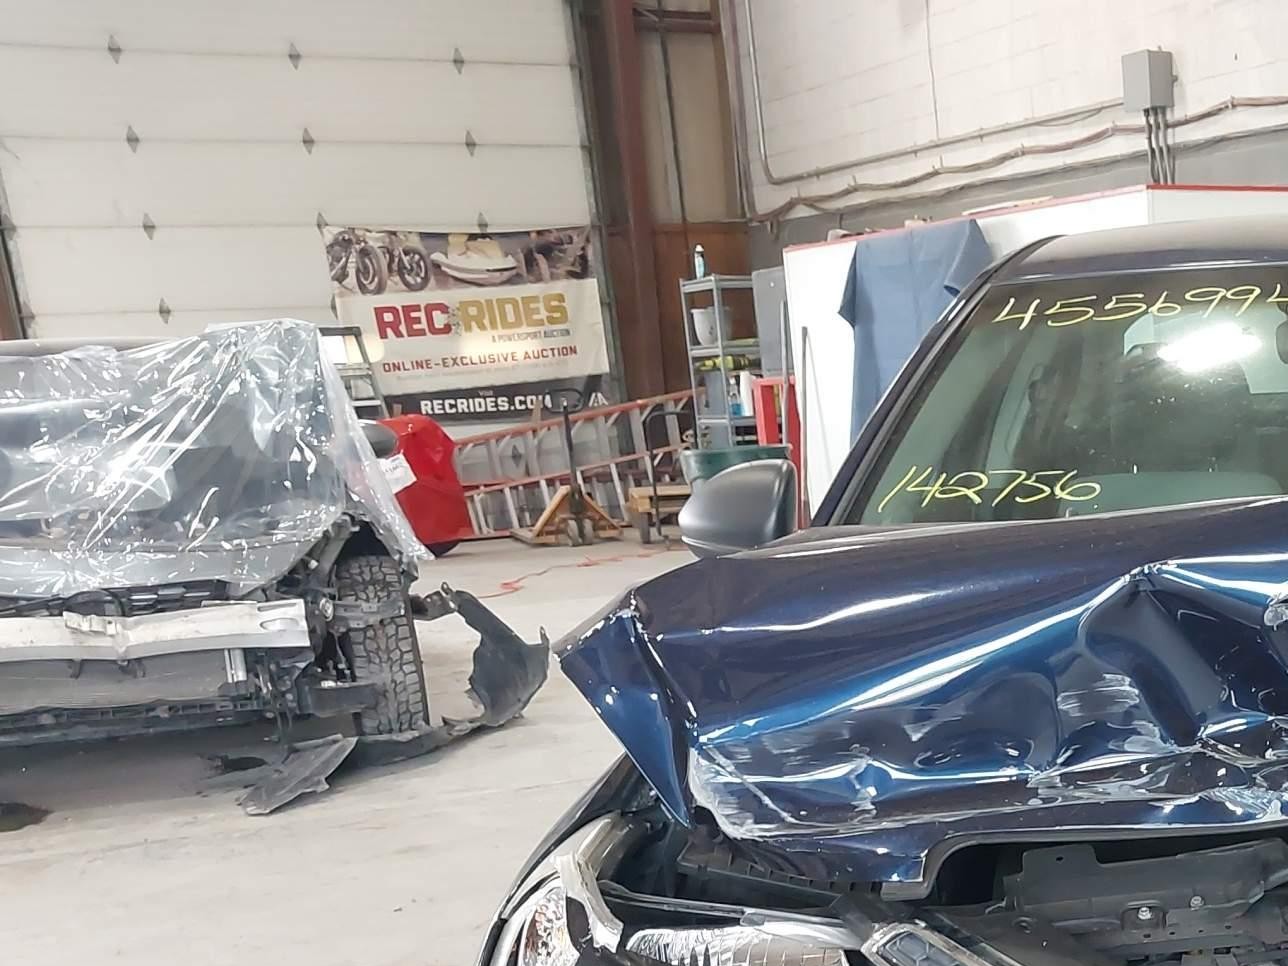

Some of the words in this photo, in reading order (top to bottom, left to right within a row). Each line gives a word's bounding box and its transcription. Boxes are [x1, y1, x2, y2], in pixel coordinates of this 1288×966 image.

[374, 302, 452, 340] REC
[458, 292, 569, 334] RIDES
[382, 352, 518, 373] ONLINE-EXCLUSIVE
[523, 345, 578, 361] AUCTION
[878, 465, 1101, 512] 142756
